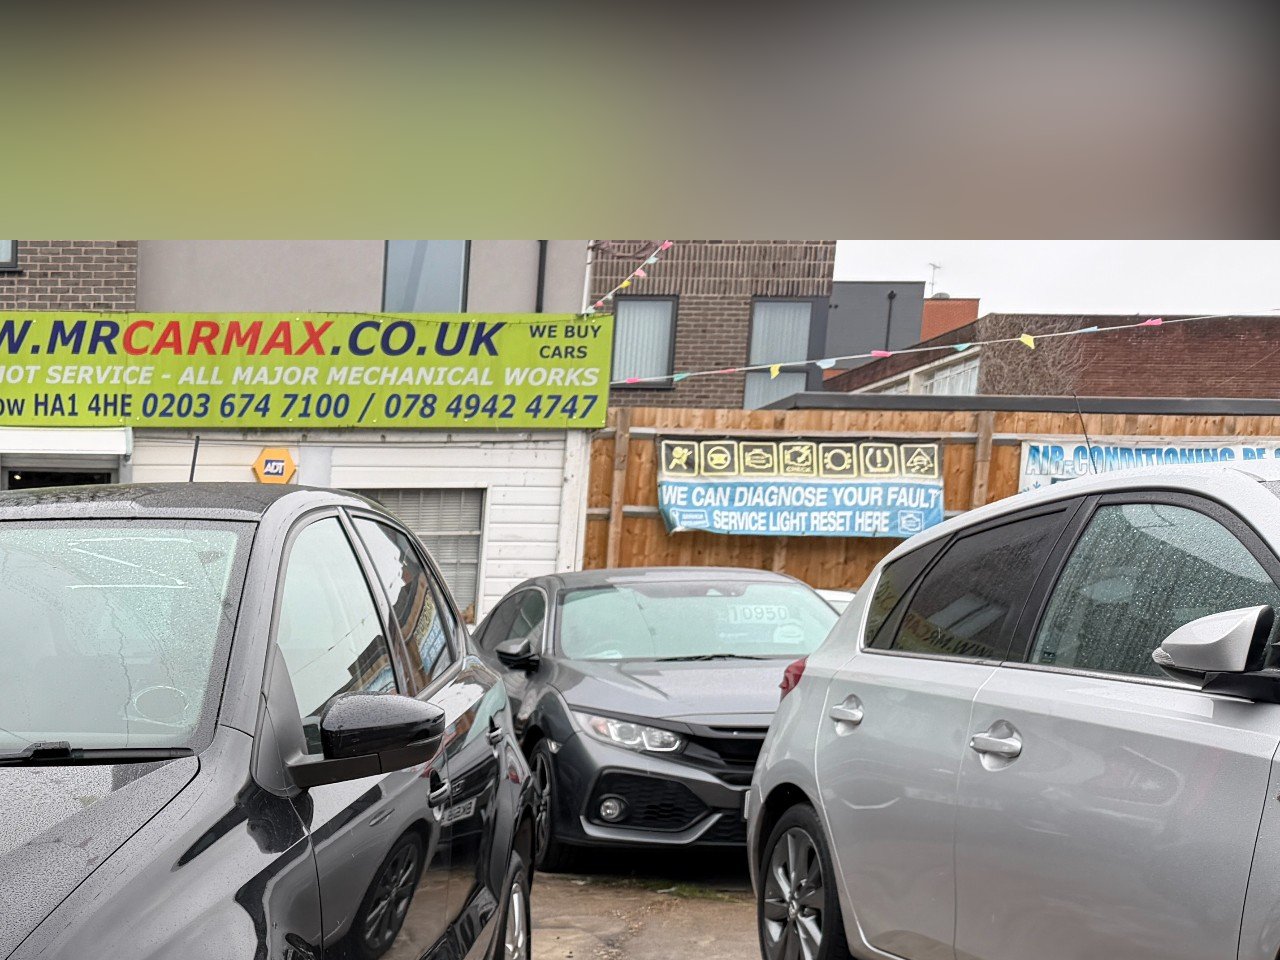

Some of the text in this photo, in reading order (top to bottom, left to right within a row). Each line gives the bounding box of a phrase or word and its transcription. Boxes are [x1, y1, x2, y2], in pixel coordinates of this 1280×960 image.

[529, 325, 602, 339] WE BUY
[539, 345, 588, 360] CARS
[48, 366, 154, 386] SERVICE
[178, 367, 223, 386] ALL
[230, 367, 319, 386] MAJOR
[325, 367, 494, 387] MECHANICAL
[504, 368, 599, 387] WORKS
[34, 394, 79, 417] HA1
[88, 394, 132, 418] 4HE
[141, 393, 210, 418] 0203
[220, 393, 270, 418] 674
[280, 393, 350, 419] 7100
[384, 394, 436, 419] 078
[445, 394, 517, 419] 4942
[525, 395, 598, 419] 4747
[264, 461, 285, 474] ADT
[661, 485, 941, 508] WE CAN DIAGNOSE YOUR FAULT
[713, 510, 767, 530] SERVICE
[770, 511, 808, 531] LIGHT
[811, 511, 852, 531] RESET
[855, 512, 889, 532] HERE
